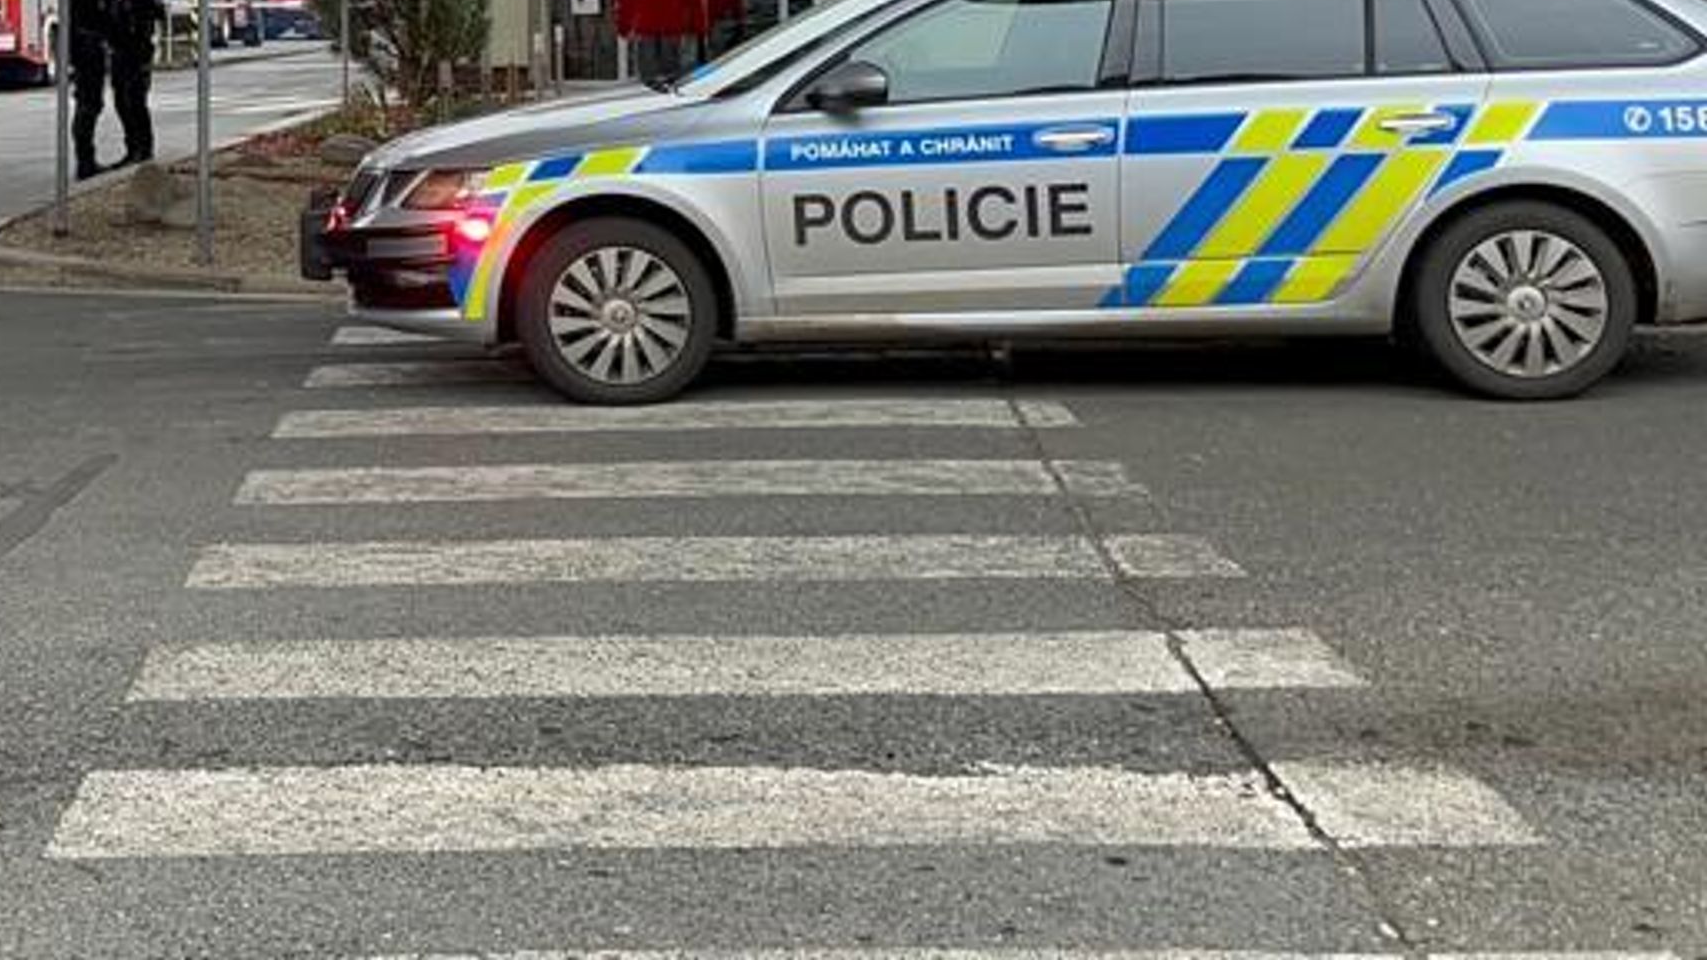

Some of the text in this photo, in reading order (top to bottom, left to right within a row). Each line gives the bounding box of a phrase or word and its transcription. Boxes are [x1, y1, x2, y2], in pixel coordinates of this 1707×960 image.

[791, 134, 1014, 161] POMÁHAT A CHRÁNIT
[793, 183, 1092, 246] POLICIE
